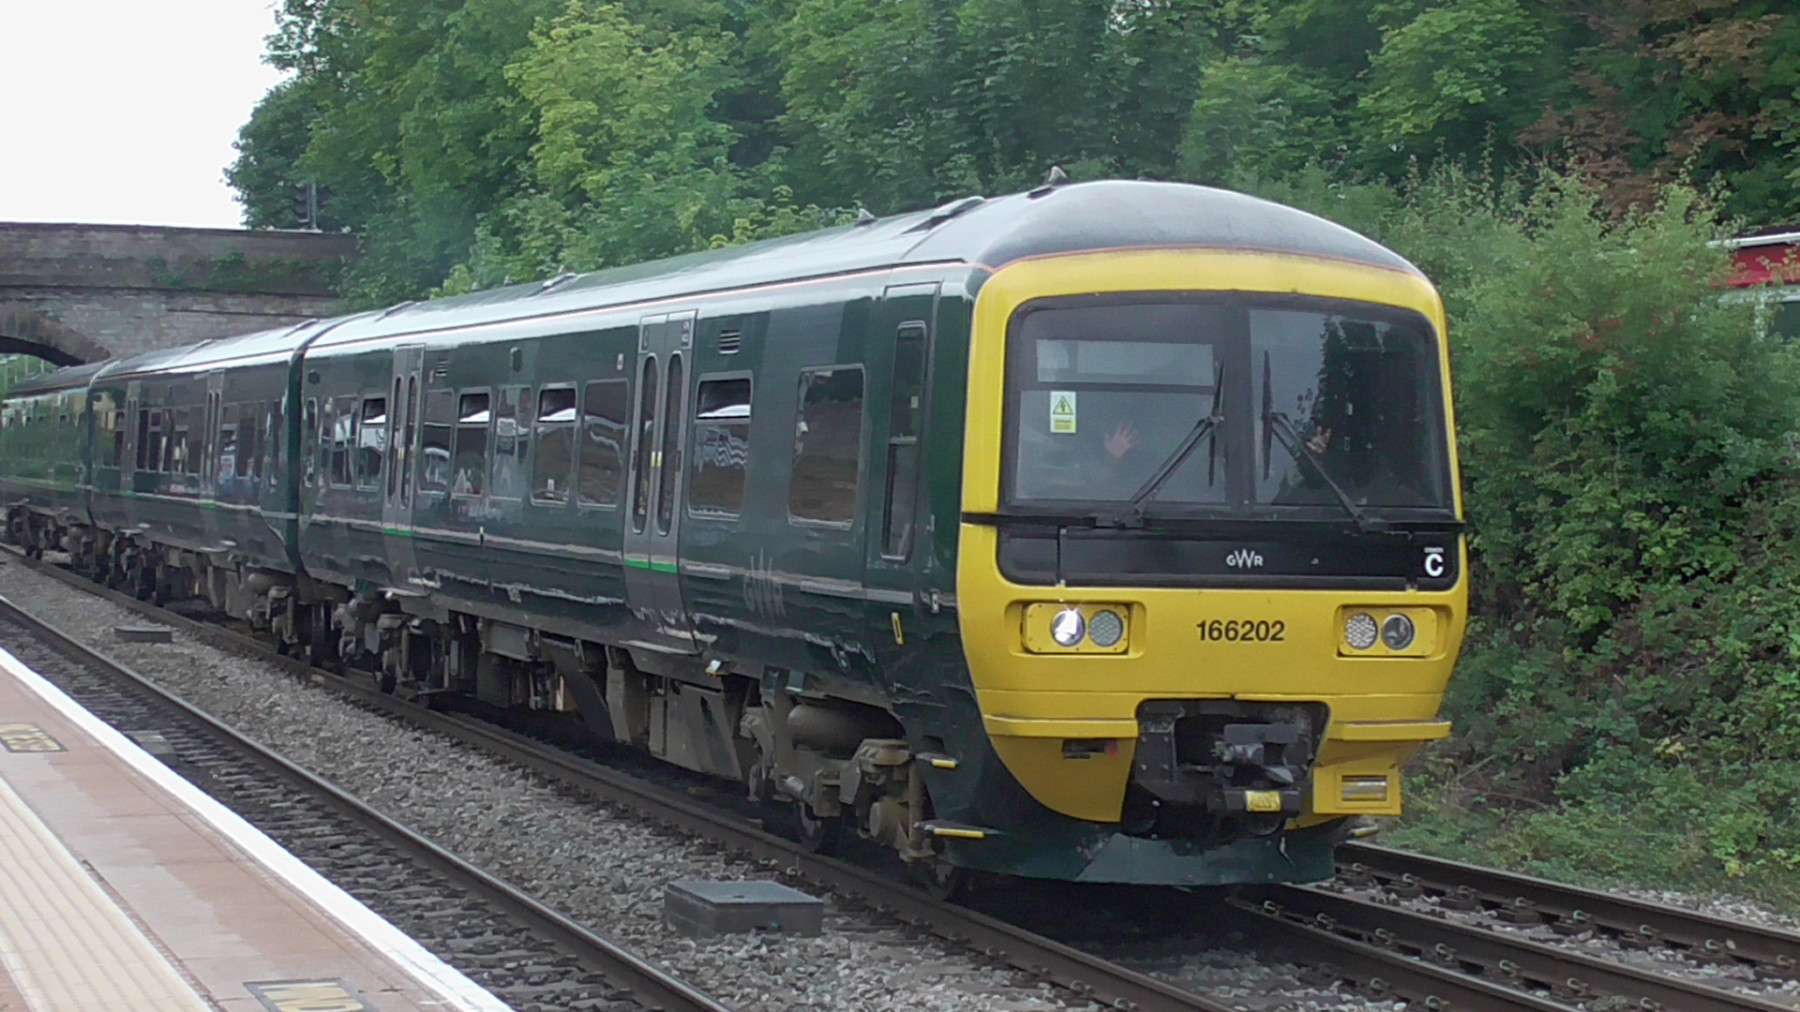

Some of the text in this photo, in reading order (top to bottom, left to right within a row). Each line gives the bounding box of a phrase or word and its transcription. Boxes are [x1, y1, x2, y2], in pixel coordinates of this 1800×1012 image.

[1226, 548, 1263, 569] GWR
[1425, 553, 1444, 577] C
[1196, 620, 1285, 642] 166202
